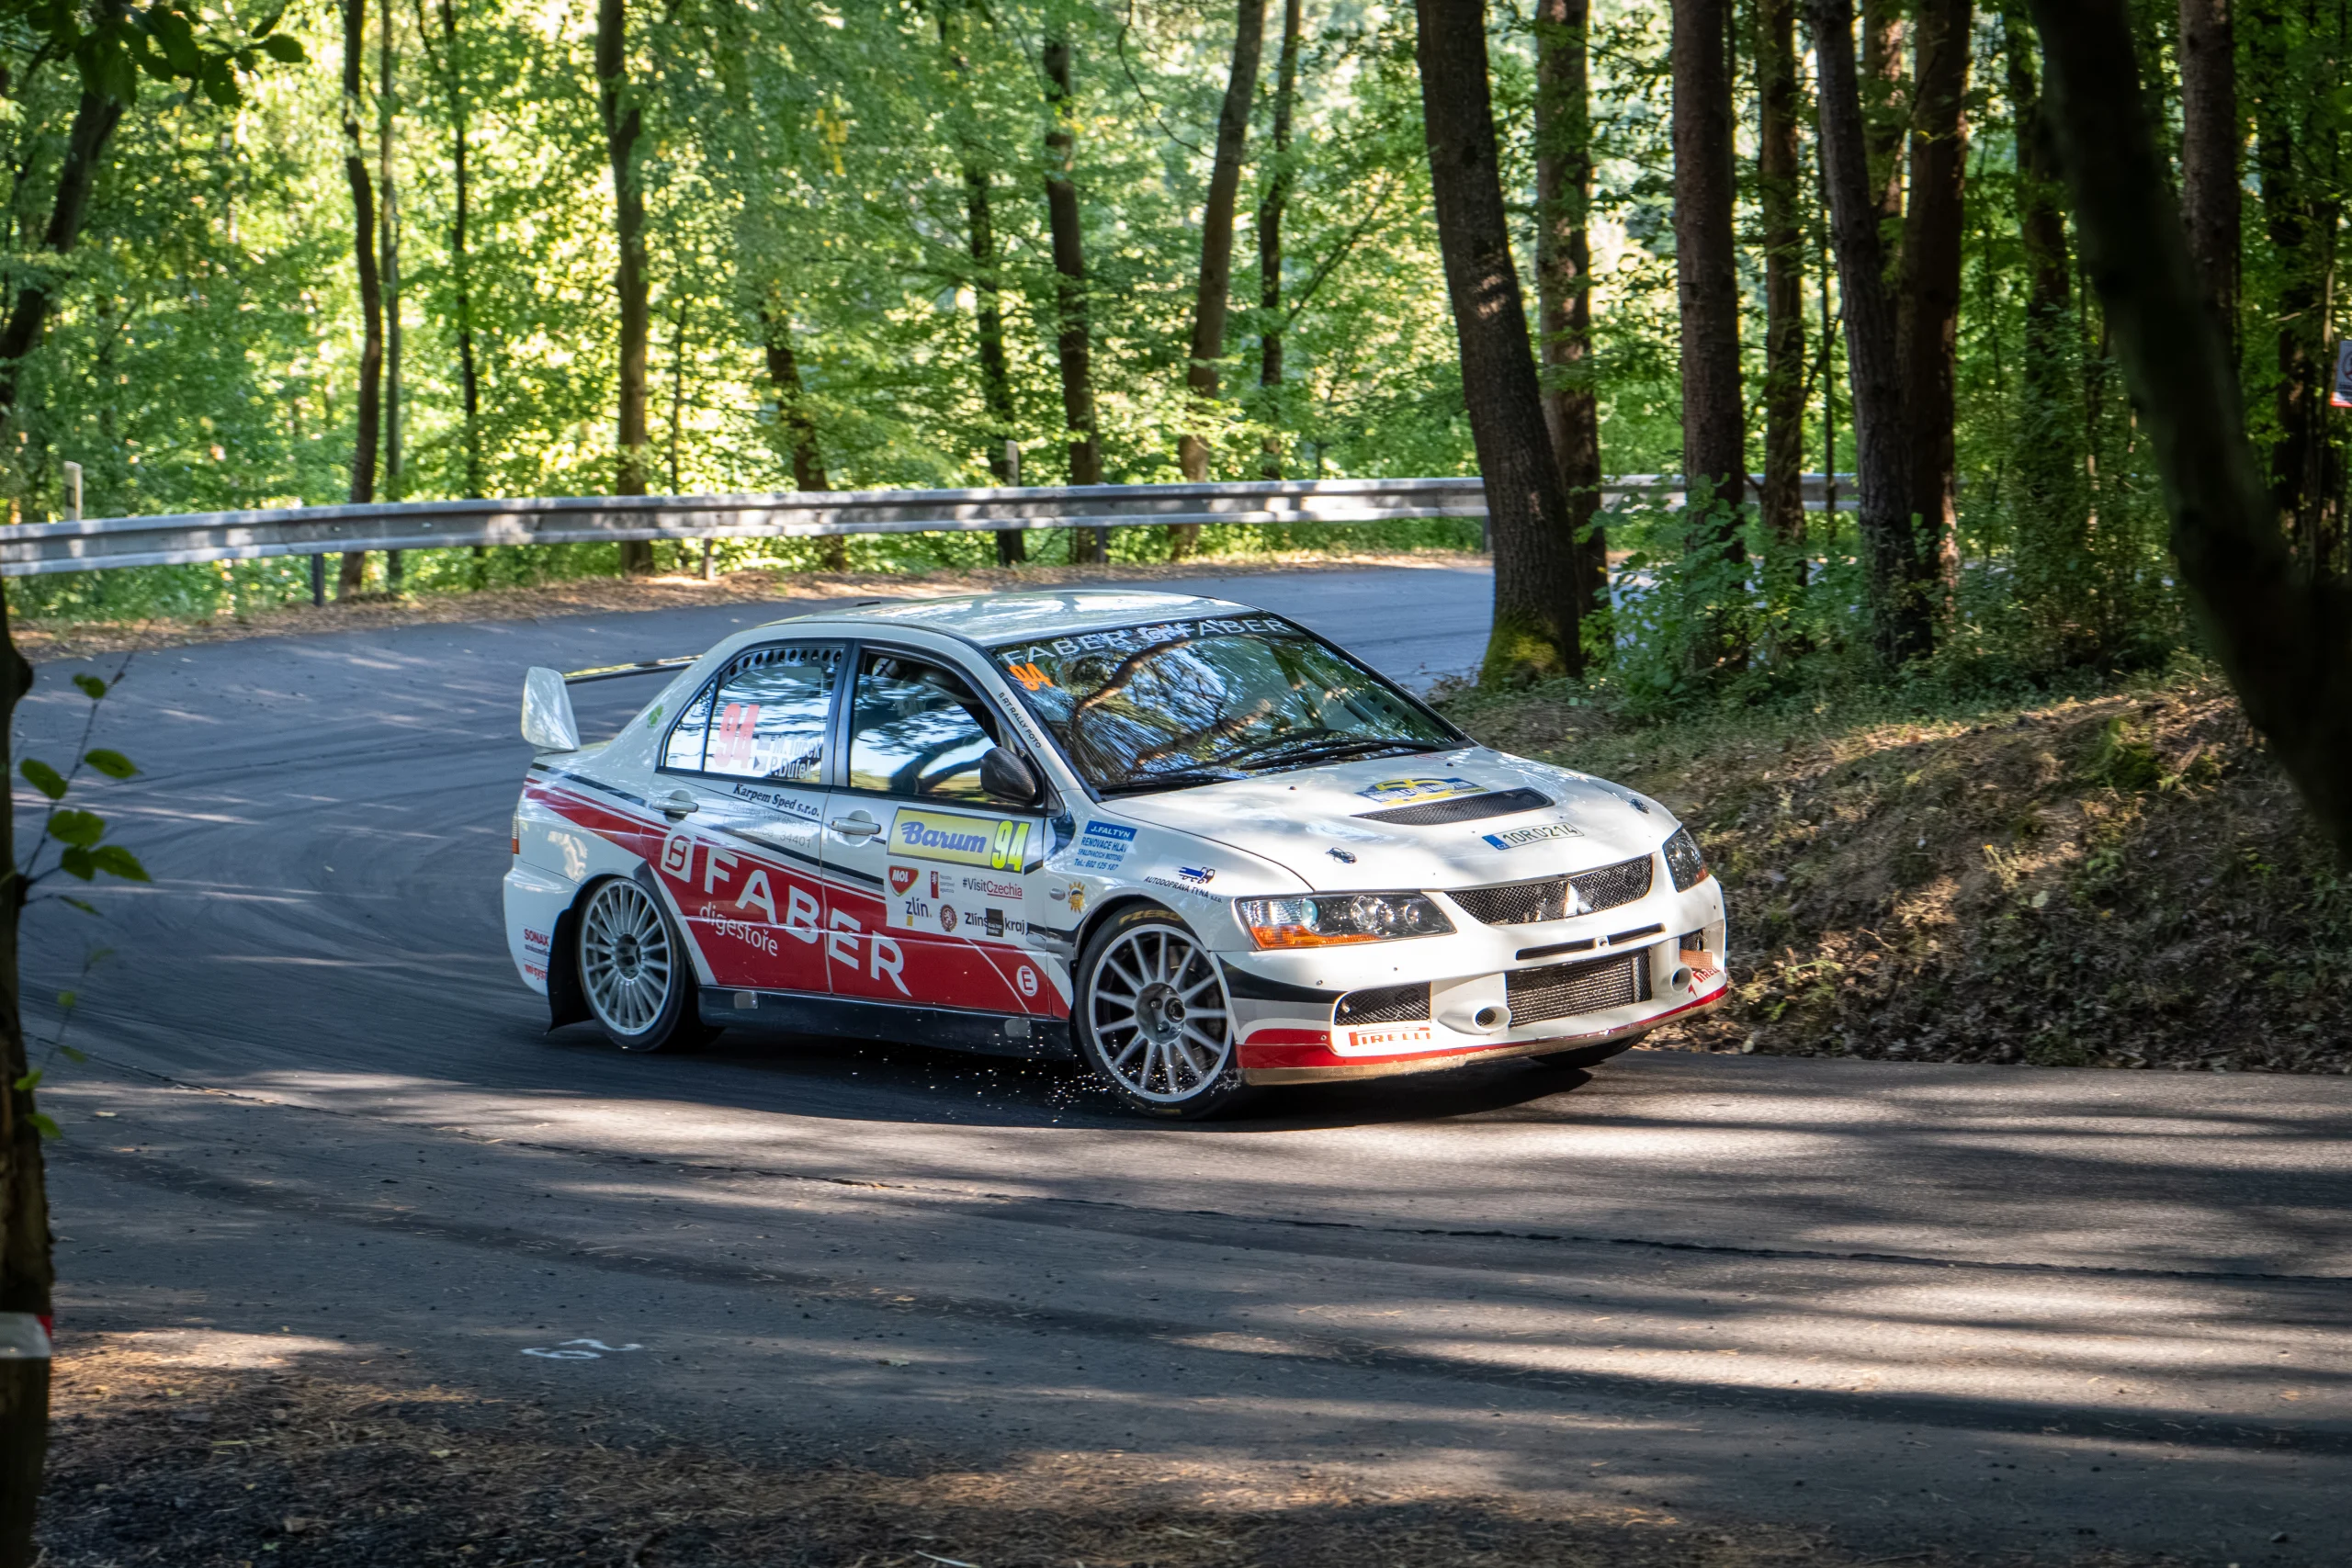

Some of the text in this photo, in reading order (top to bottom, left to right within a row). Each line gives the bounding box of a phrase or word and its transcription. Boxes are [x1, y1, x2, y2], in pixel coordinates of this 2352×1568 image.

[1002, 630, 1127, 665] FABER
[1009, 662, 1054, 691] 94
[713, 703, 761, 769] 94
[1010, 706, 1028, 728] RALLY
[1025, 728, 1042, 749] FOTO
[732, 783, 820, 817] Karpem Sped s.r.o.
[779, 830, 811, 849] 34401
[900, 820, 988, 853] Barum
[991, 820, 1030, 872] 94
[1081, 837, 1113, 851] RENOVACE
[891, 869, 909, 883] MOL
[963, 877, 1023, 897] #VisitCzechia
[1144, 876, 1190, 893] AUTODOPRAVA
[699, 901, 779, 957] digestoře
[704, 845, 913, 998] FABER
[965, 912, 989, 929] Zlíns
[1004, 917, 1025, 935] kraj
[524, 928, 549, 947] SONAX
[1348, 1026, 1430, 1047] PIRELLI
